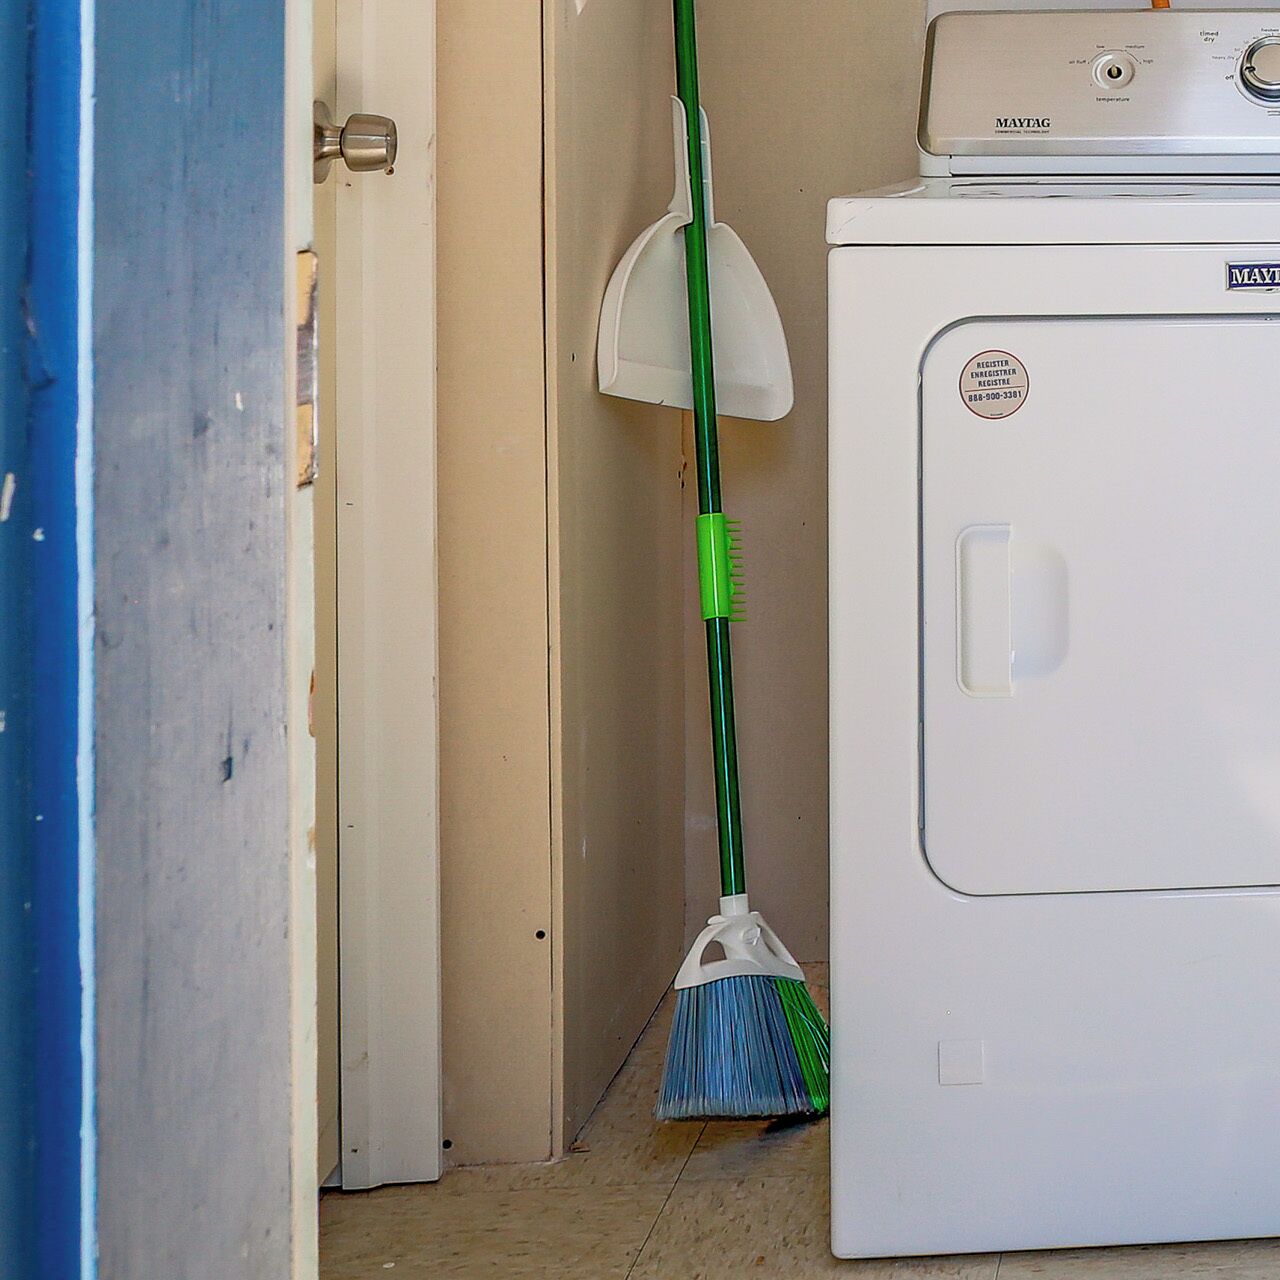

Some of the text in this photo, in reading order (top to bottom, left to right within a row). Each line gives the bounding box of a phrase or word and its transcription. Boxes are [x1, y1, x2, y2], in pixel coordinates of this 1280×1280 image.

[995, 117, 1051, 128] MAYTAG
[976, 359, 1009, 369] REGISTER
[970, 368, 1017, 379] ENREGISTRER
[978, 378, 1010, 387] REGISTRE
[968, 390, 1022, 402] 888-900-3381
